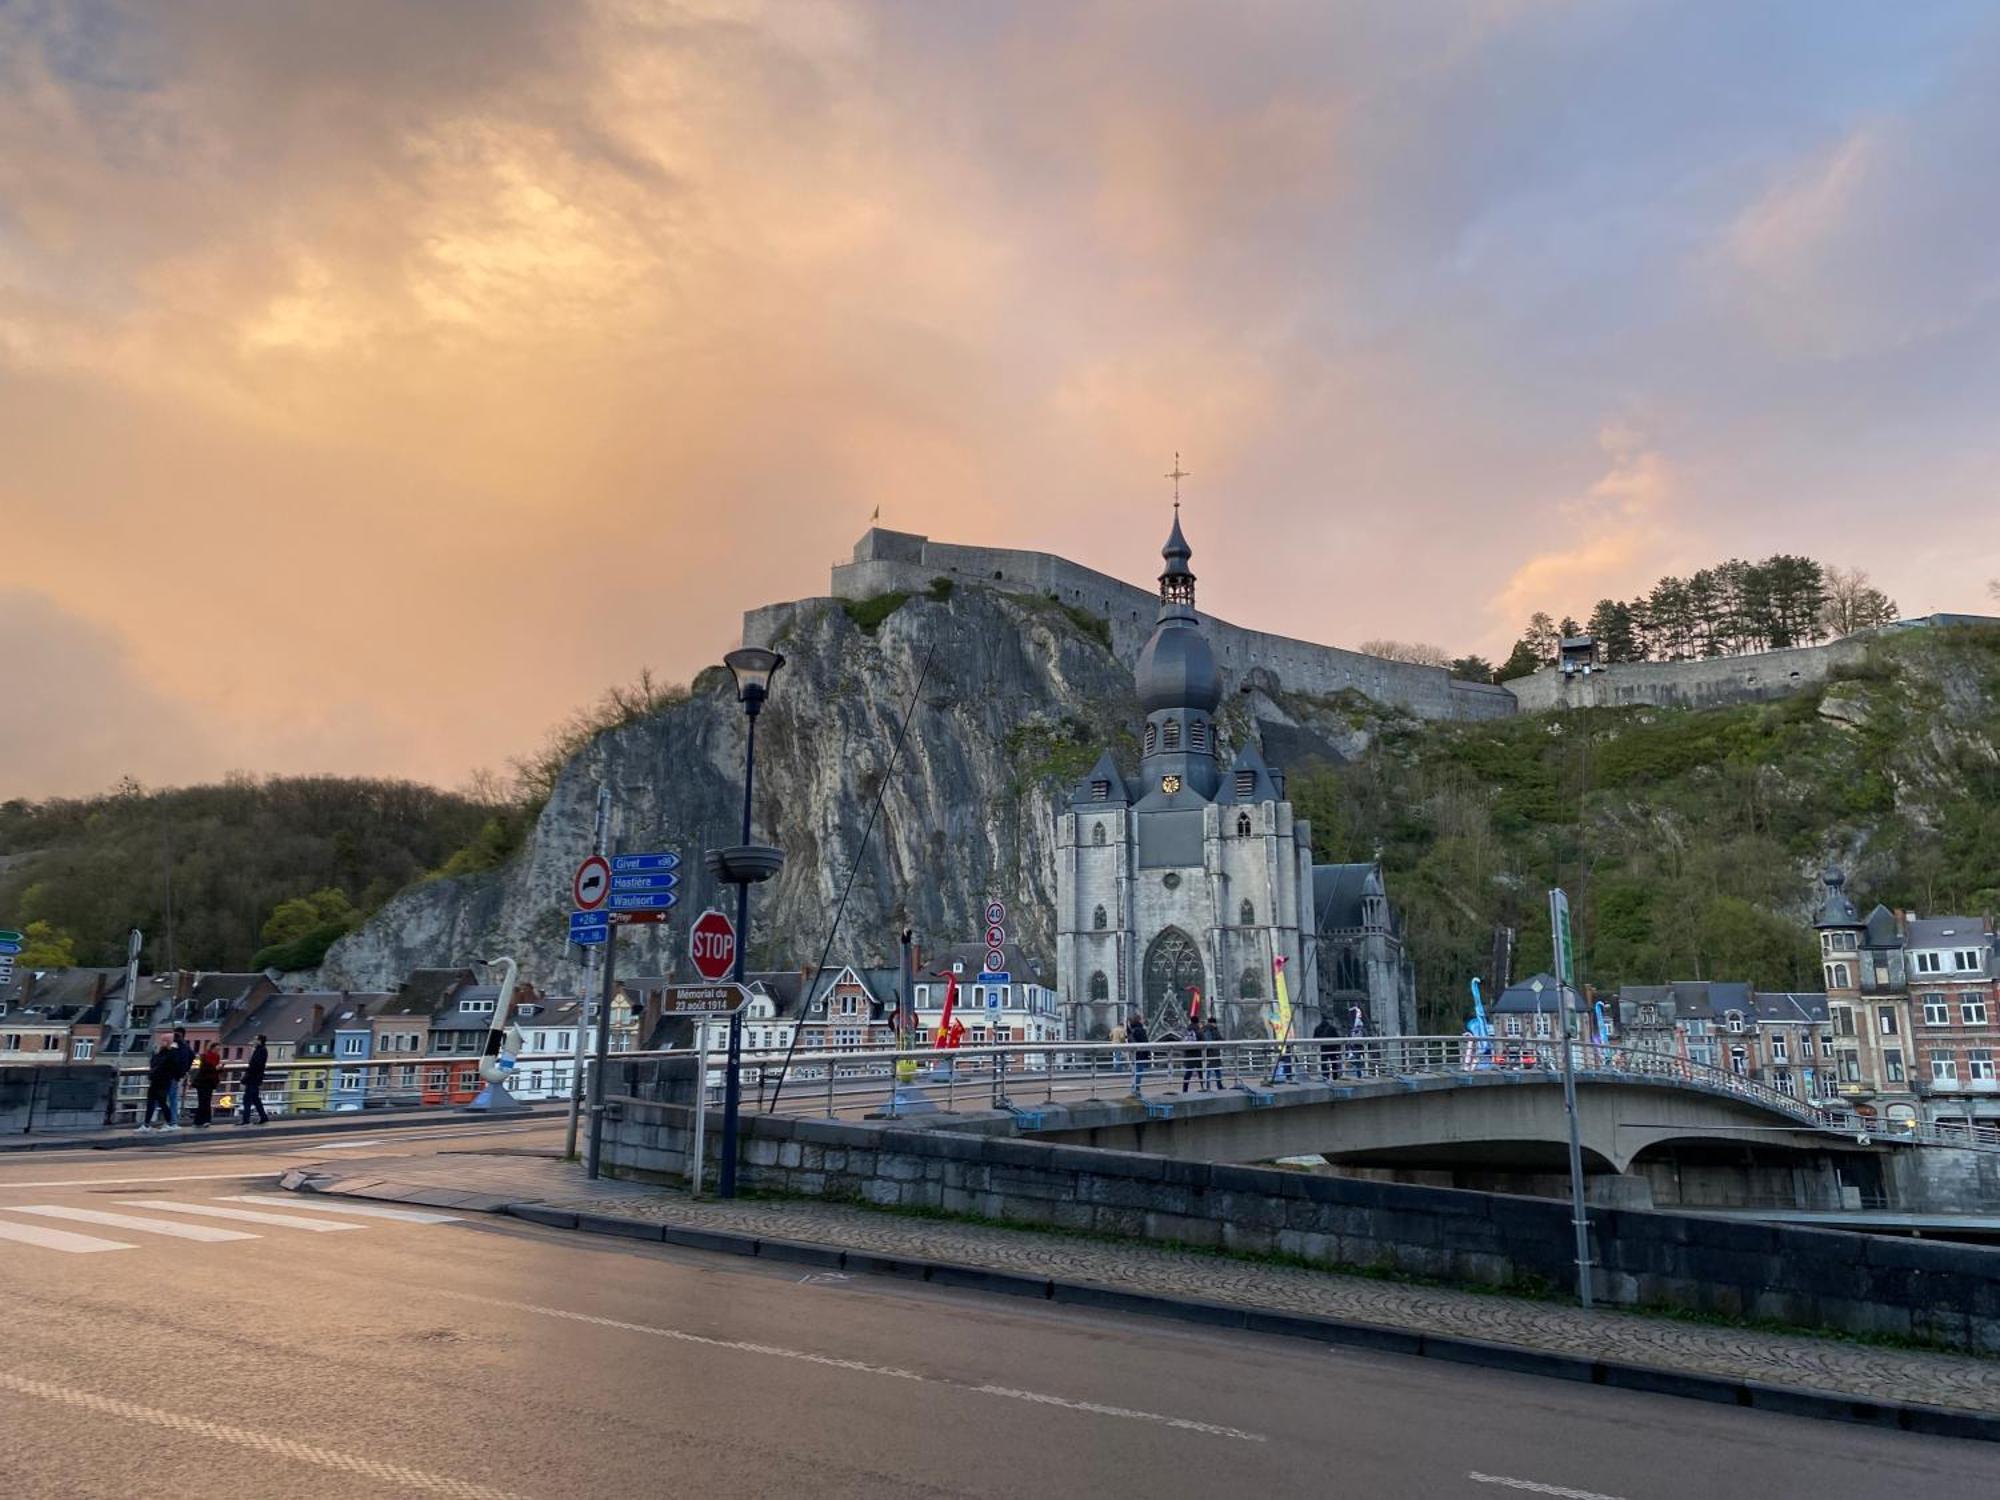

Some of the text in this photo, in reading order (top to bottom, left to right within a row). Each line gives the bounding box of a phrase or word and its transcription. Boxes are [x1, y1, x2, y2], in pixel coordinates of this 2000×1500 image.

[614, 878, 652, 888] Hastière
[614, 896, 654, 906] Waulsort
[989, 909, 1000, 918] 40
[694, 931, 733, 960] STOP
[677, 989, 728, 999] Mémorial du
[676, 1000, 727, 1010] 23 août 1914
